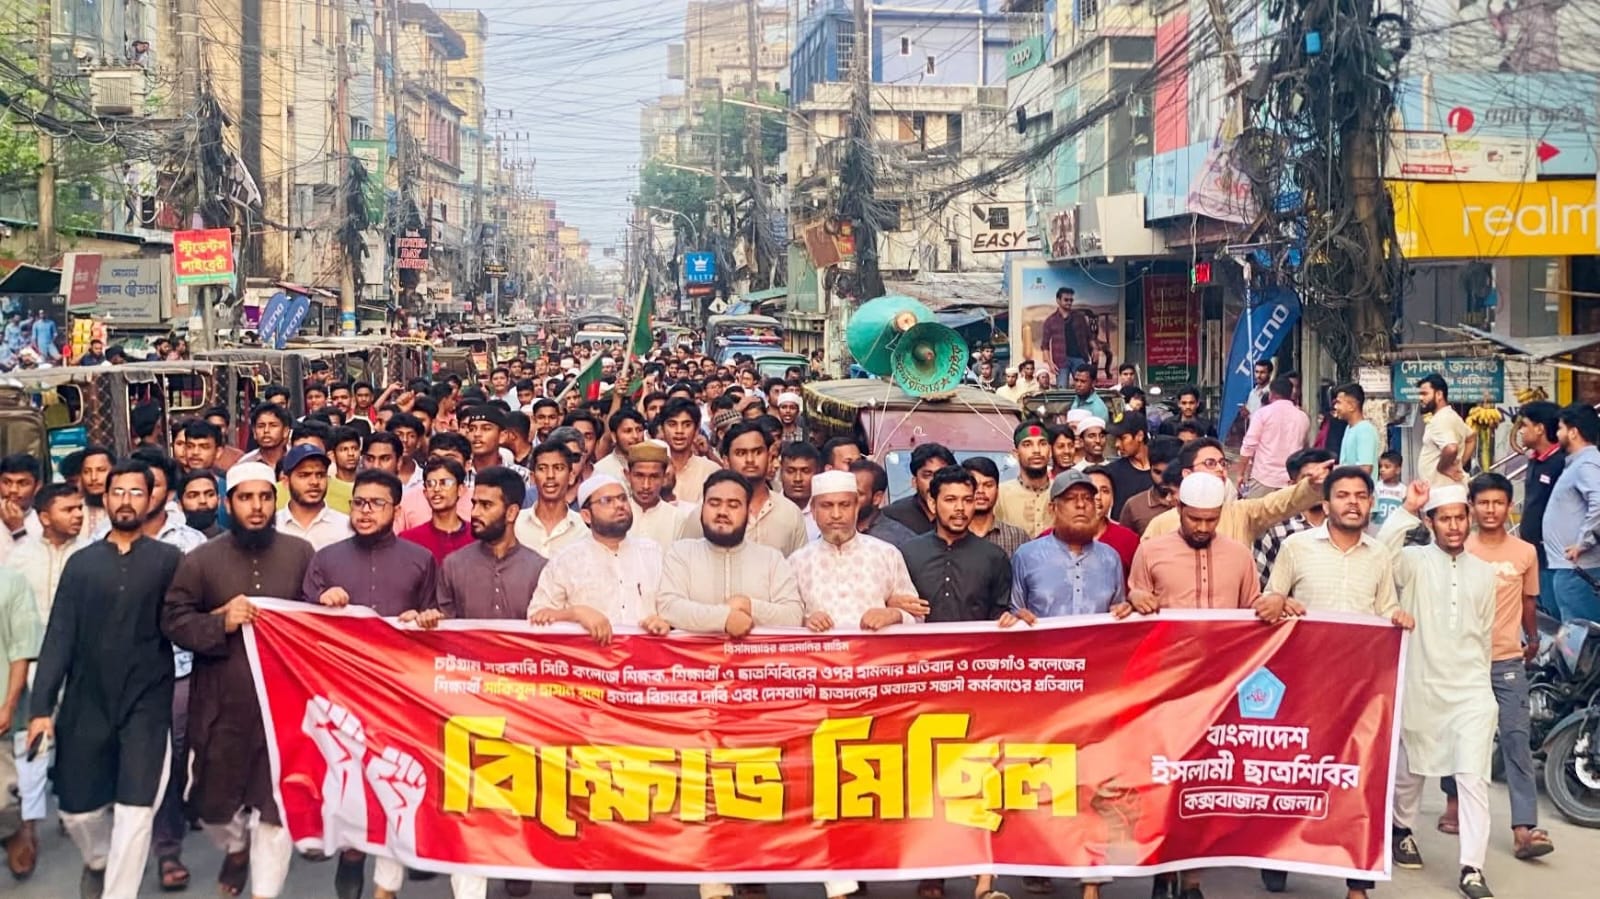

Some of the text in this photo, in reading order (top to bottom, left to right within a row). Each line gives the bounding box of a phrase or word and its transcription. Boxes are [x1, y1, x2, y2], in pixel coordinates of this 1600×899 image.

[973, 231, 1025, 249] EASY
[1234, 303, 1290, 376] TECNO
[540, 657, 569, 677] সিটি
[572, 664, 620, 683] কলেজে
[722, 670, 735, 681] ও
[738, 660, 818, 681] ছাত্রশিবিরের
[821, 665, 853, 680] ওপর
[856, 664, 904, 679] হামলার
[907, 658, 954, 676] প্রতিবাদ
[957, 659, 969, 671] ও
[972, 654, 1025, 672] তেজগাঁও
[1028, 657, 1086, 672] কলেজের
[646, 686, 698, 705] বিচারের
[701, 683, 729, 704] দাবি
[731, 686, 758, 702] এবং
[761, 683, 816, 701] দেশব্যাপী
[818, 684, 877, 701] ছাত্রদলের
[880, 681, 927, 696] অব্যাহত
[967, 675, 1031, 693] কর্মকাণ্ডের
[1034, 674, 1084, 693] প্রতিবাদে
[1206, 724, 1309, 750] বাংলাদেশ
[443, 713, 1079, 838] বিক্ষোভ মিছিল
[1151, 750, 1360, 790] ইসলামী ছাত্রশিবির
[1184, 791, 1270, 811] কক্সবাজার
